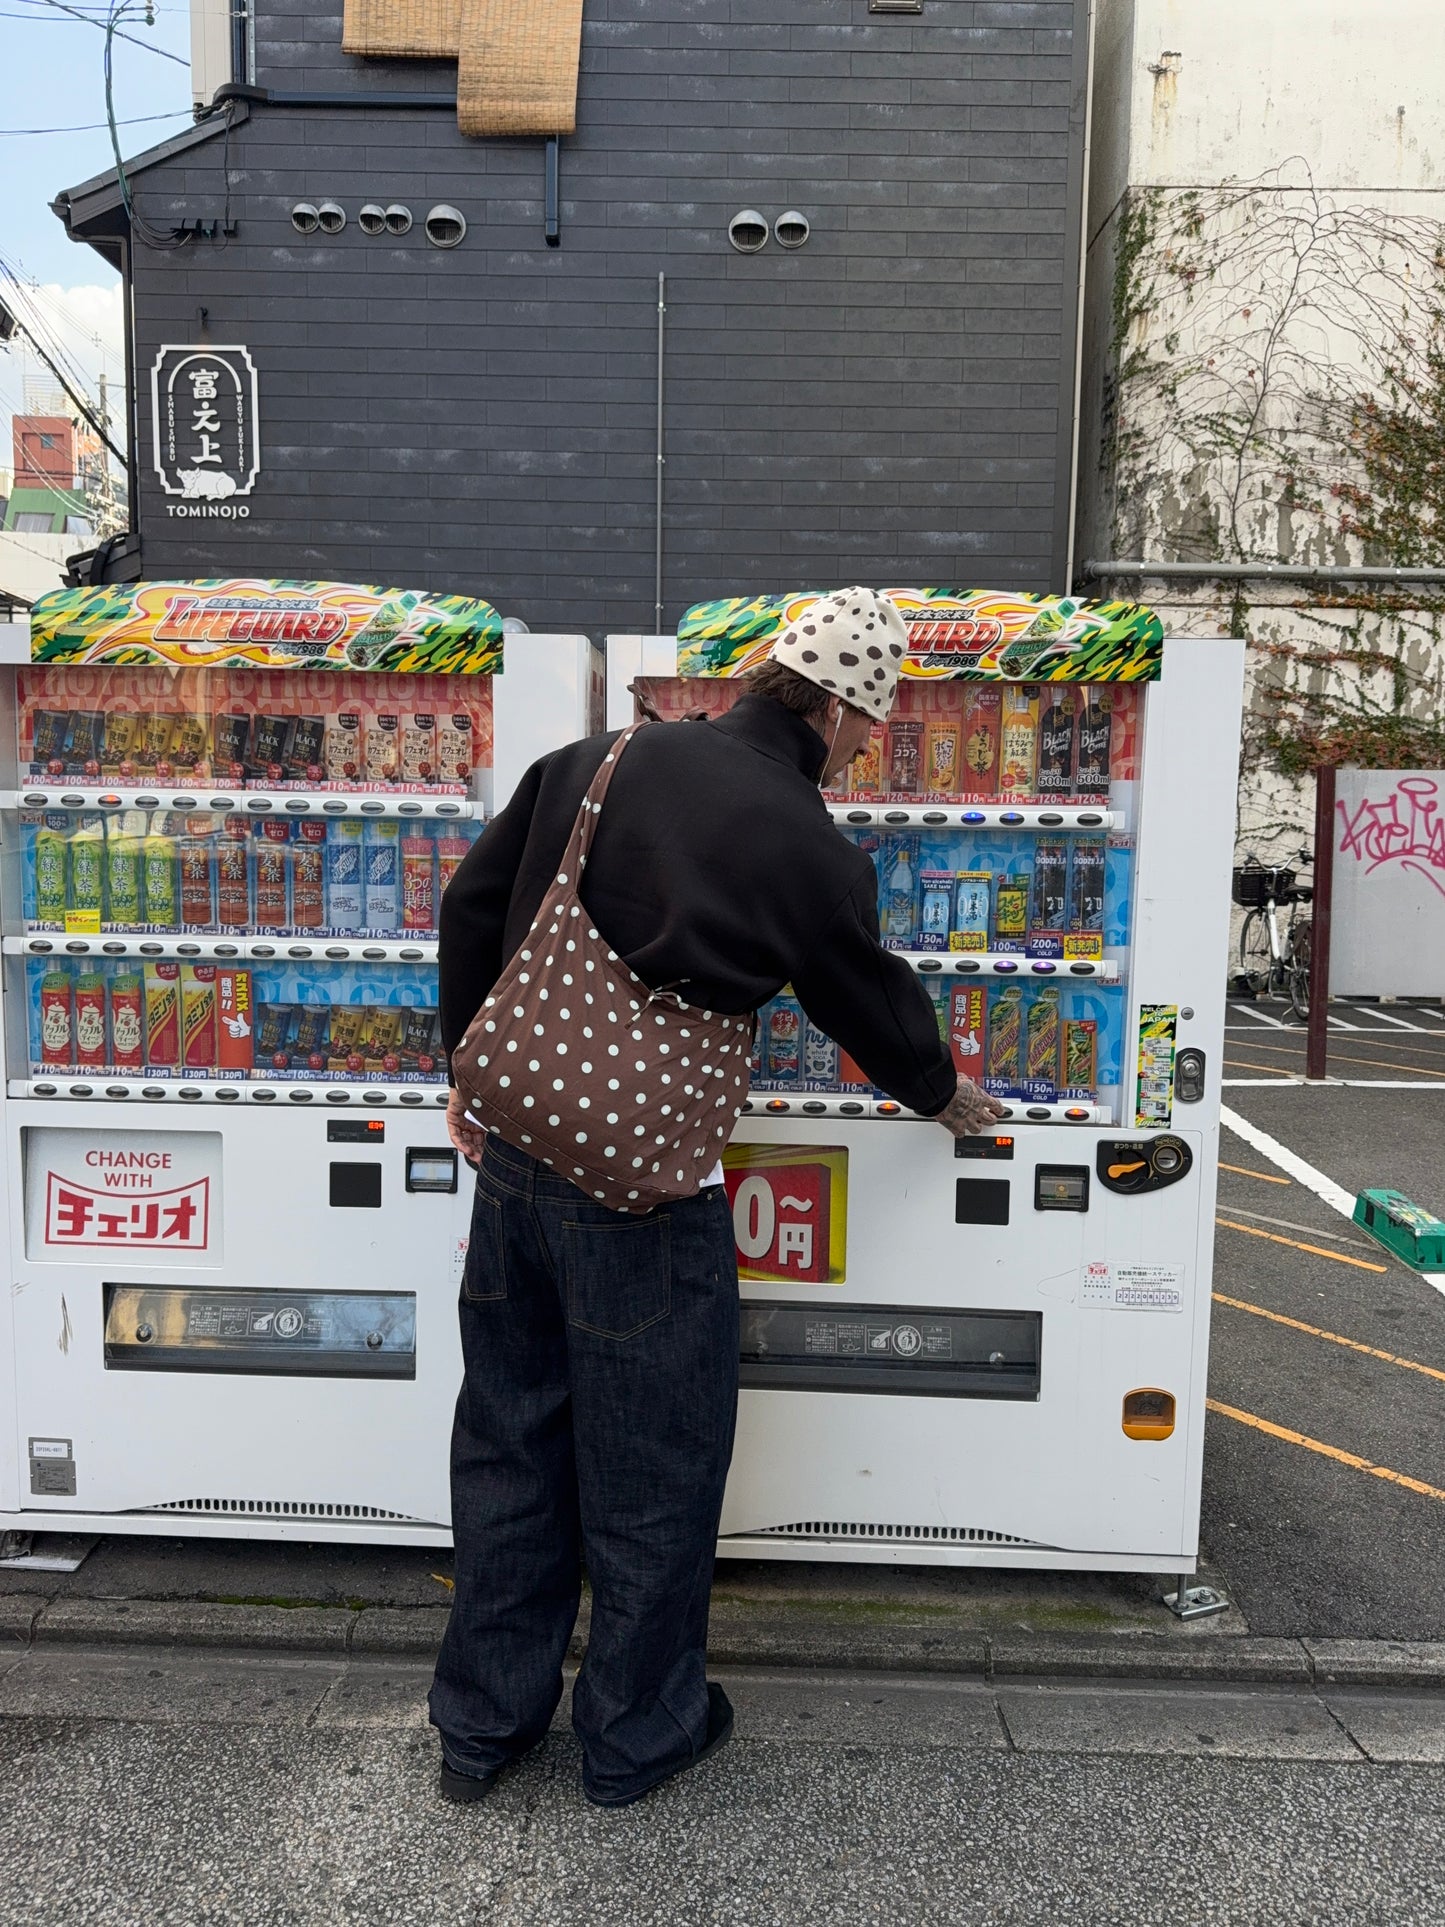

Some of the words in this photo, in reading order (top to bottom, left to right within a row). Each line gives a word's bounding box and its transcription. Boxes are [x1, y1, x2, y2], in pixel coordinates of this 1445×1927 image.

[168, 430, 176, 461] SHABU
[166, 505, 250, 519] TOMINOJO
[154, 597, 347, 642] LIFEGUARD
[905, 619, 1000, 654] UARD
[295, 645, 325, 656] 1986
[949, 656, 978, 667] 1986
[1043, 728, 1072, 749] BLACK
[1081, 726, 1109, 749] BLACK
[894, 749, 917, 759] ココア
[974, 725, 991, 780] ほうじ茶
[1038, 775, 1072, 787] 500ml
[1076, 774, 1110, 785] 500ml
[961, 794, 984, 803] 110円
[1000, 794, 1023, 804] 110円
[185, 849, 205, 880] 麦茶
[223, 850, 243, 880] 麦茶
[262, 853, 281, 882] 麦茶
[300, 852, 319, 882] 麦茶
[41, 857, 57, 890] 緑茶
[77, 860, 93, 893] 緑茶
[112, 857, 129, 891] 緑茶
[149, 860, 165, 894] 緑茶
[403, 872, 433, 891] 3つの
[404, 890, 432, 911] 果実
[919, 934, 943, 944] 150円
[954, 935, 984, 950] 新発売!
[993, 941, 1016, 951] 100円
[1032, 939, 1058, 949] 200円
[1068, 938, 1099, 953] 新発売!
[235, 973, 249, 1012] オススメ
[969, 990, 982, 1030] オススメ
[407, 1025, 428, 1038] BLACK
[147, 1069, 169, 1077] 130円
[184, 1070, 206, 1078] 130円
[220, 1071, 241, 1079] 130円
[985, 1079, 1009, 1089] 150円
[1028, 1083, 1053, 1093] 150円
[1066, 1090, 1089, 1098] 110円
[85, 1150, 172, 1169] CHANGE
[104, 1172, 153, 1188] WITH
[57, 1187, 197, 1241] チェリオ
